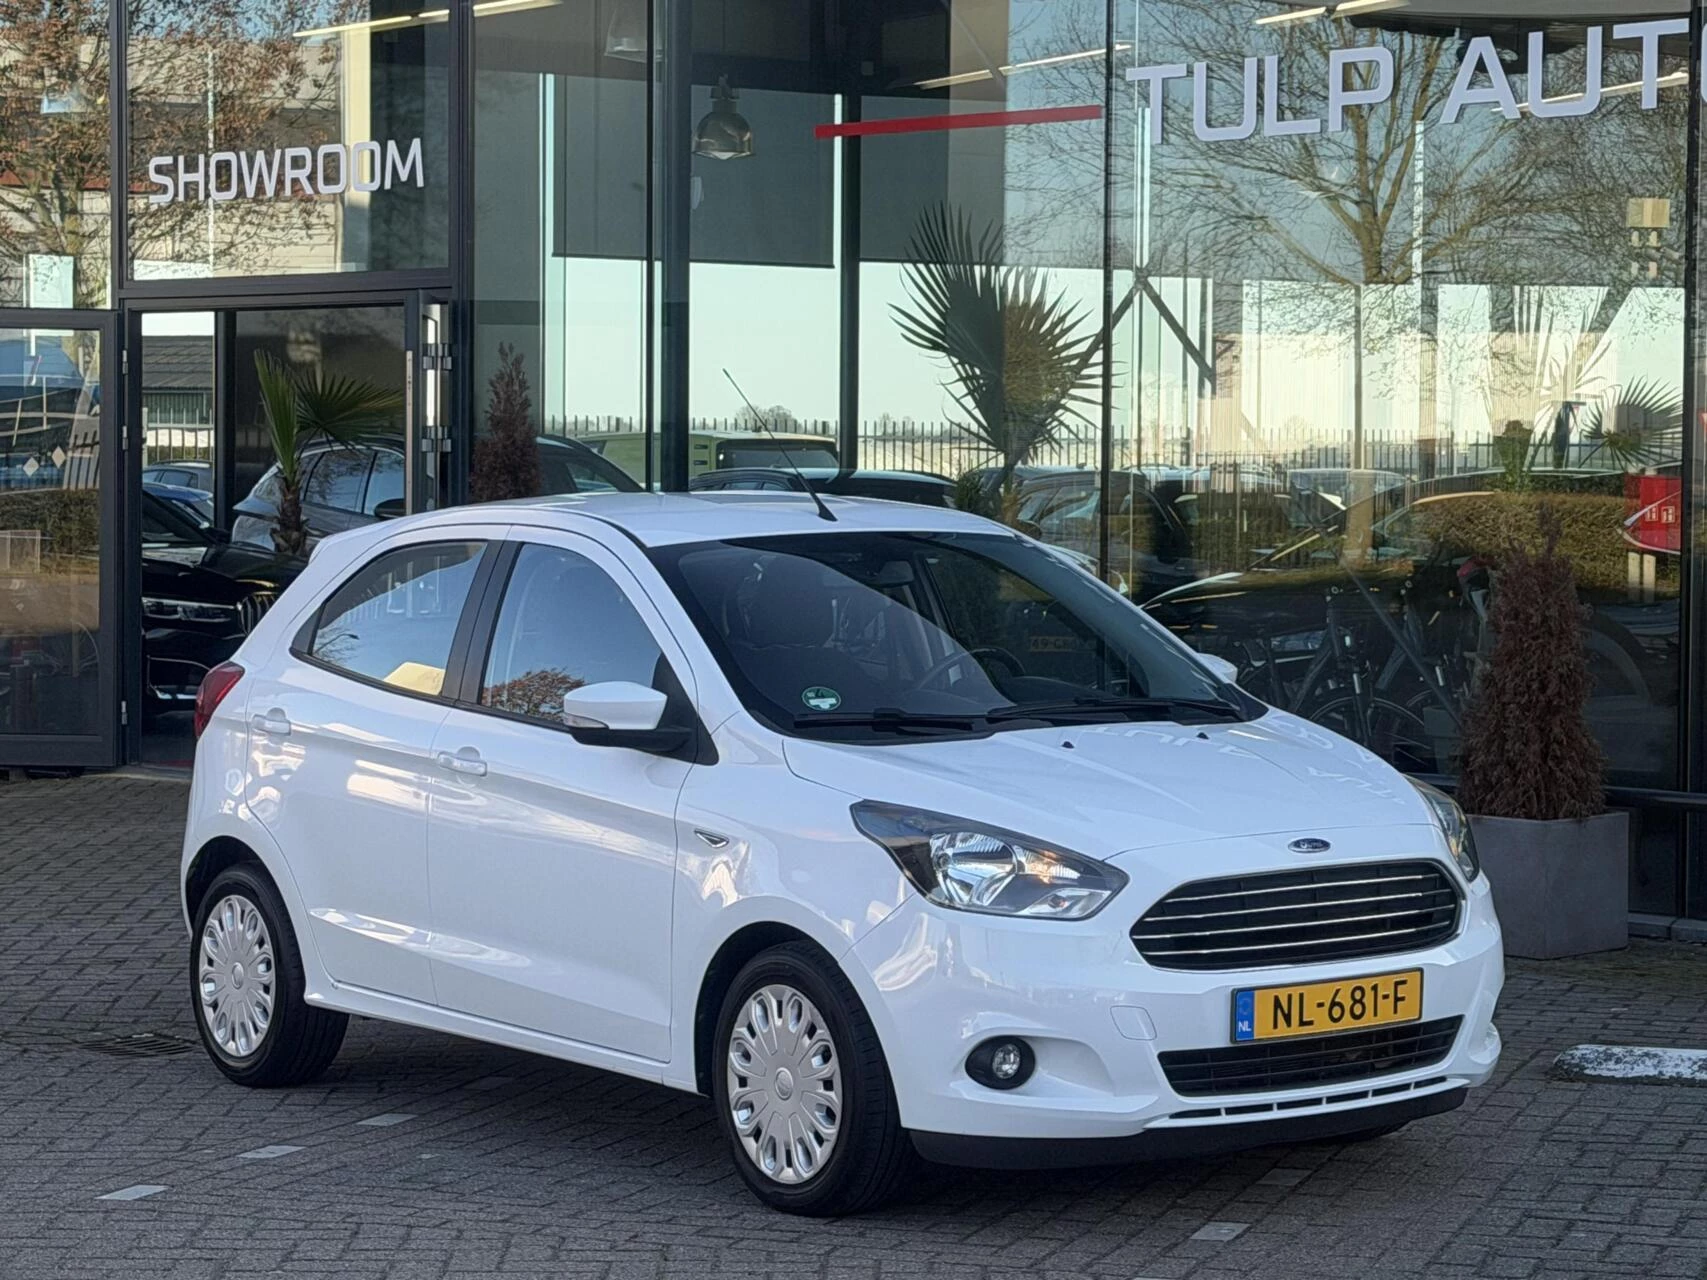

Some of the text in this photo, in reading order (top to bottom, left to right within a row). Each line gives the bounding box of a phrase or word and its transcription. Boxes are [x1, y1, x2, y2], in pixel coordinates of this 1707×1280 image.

[1126, 18, 1707, 145] TULP AUT
[148, 137, 424, 205] SHOWROOM
[1238, 1020, 1252, 1032] NL
[1273, 979, 1408, 1030] NL-681-F
